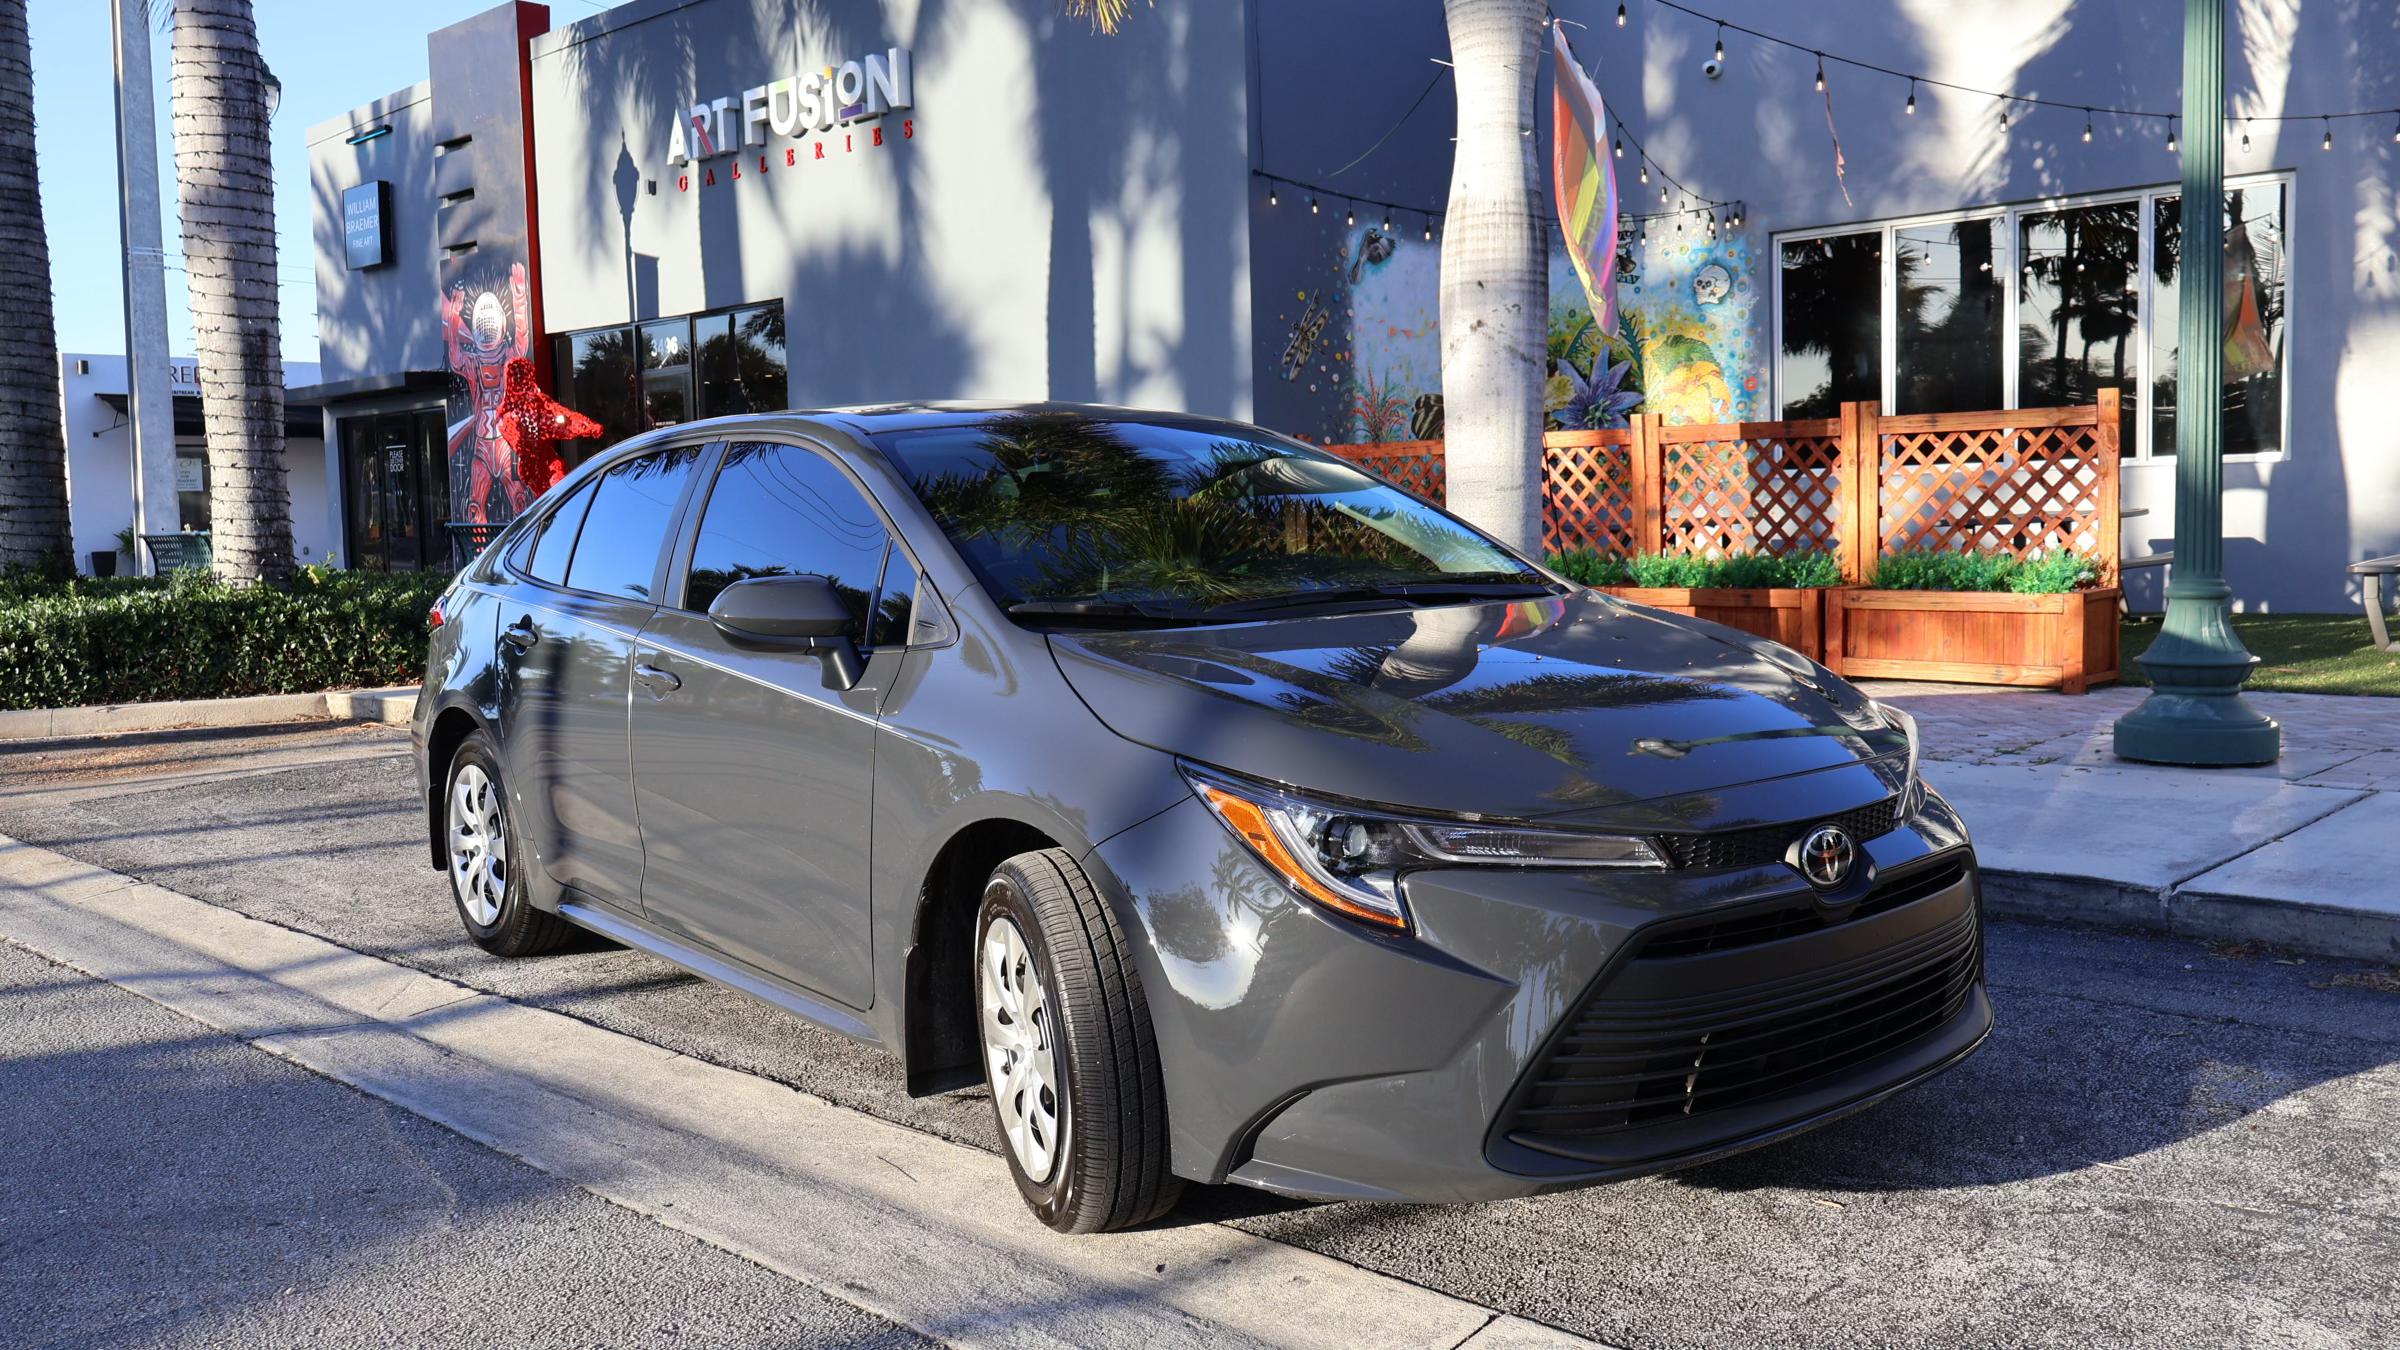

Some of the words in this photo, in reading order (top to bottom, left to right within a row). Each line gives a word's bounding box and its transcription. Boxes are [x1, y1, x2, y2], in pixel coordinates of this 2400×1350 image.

[667, 96, 739, 165] ART
[678, 119, 913, 193] GALLERIES
[346, 197, 376, 216] WILLIAM
[346, 215, 379, 235] BRAEMER
[352, 238, 363, 249] FINE
[364, 235, 373, 246] ART
[390, 463, 404, 473] DOOR
